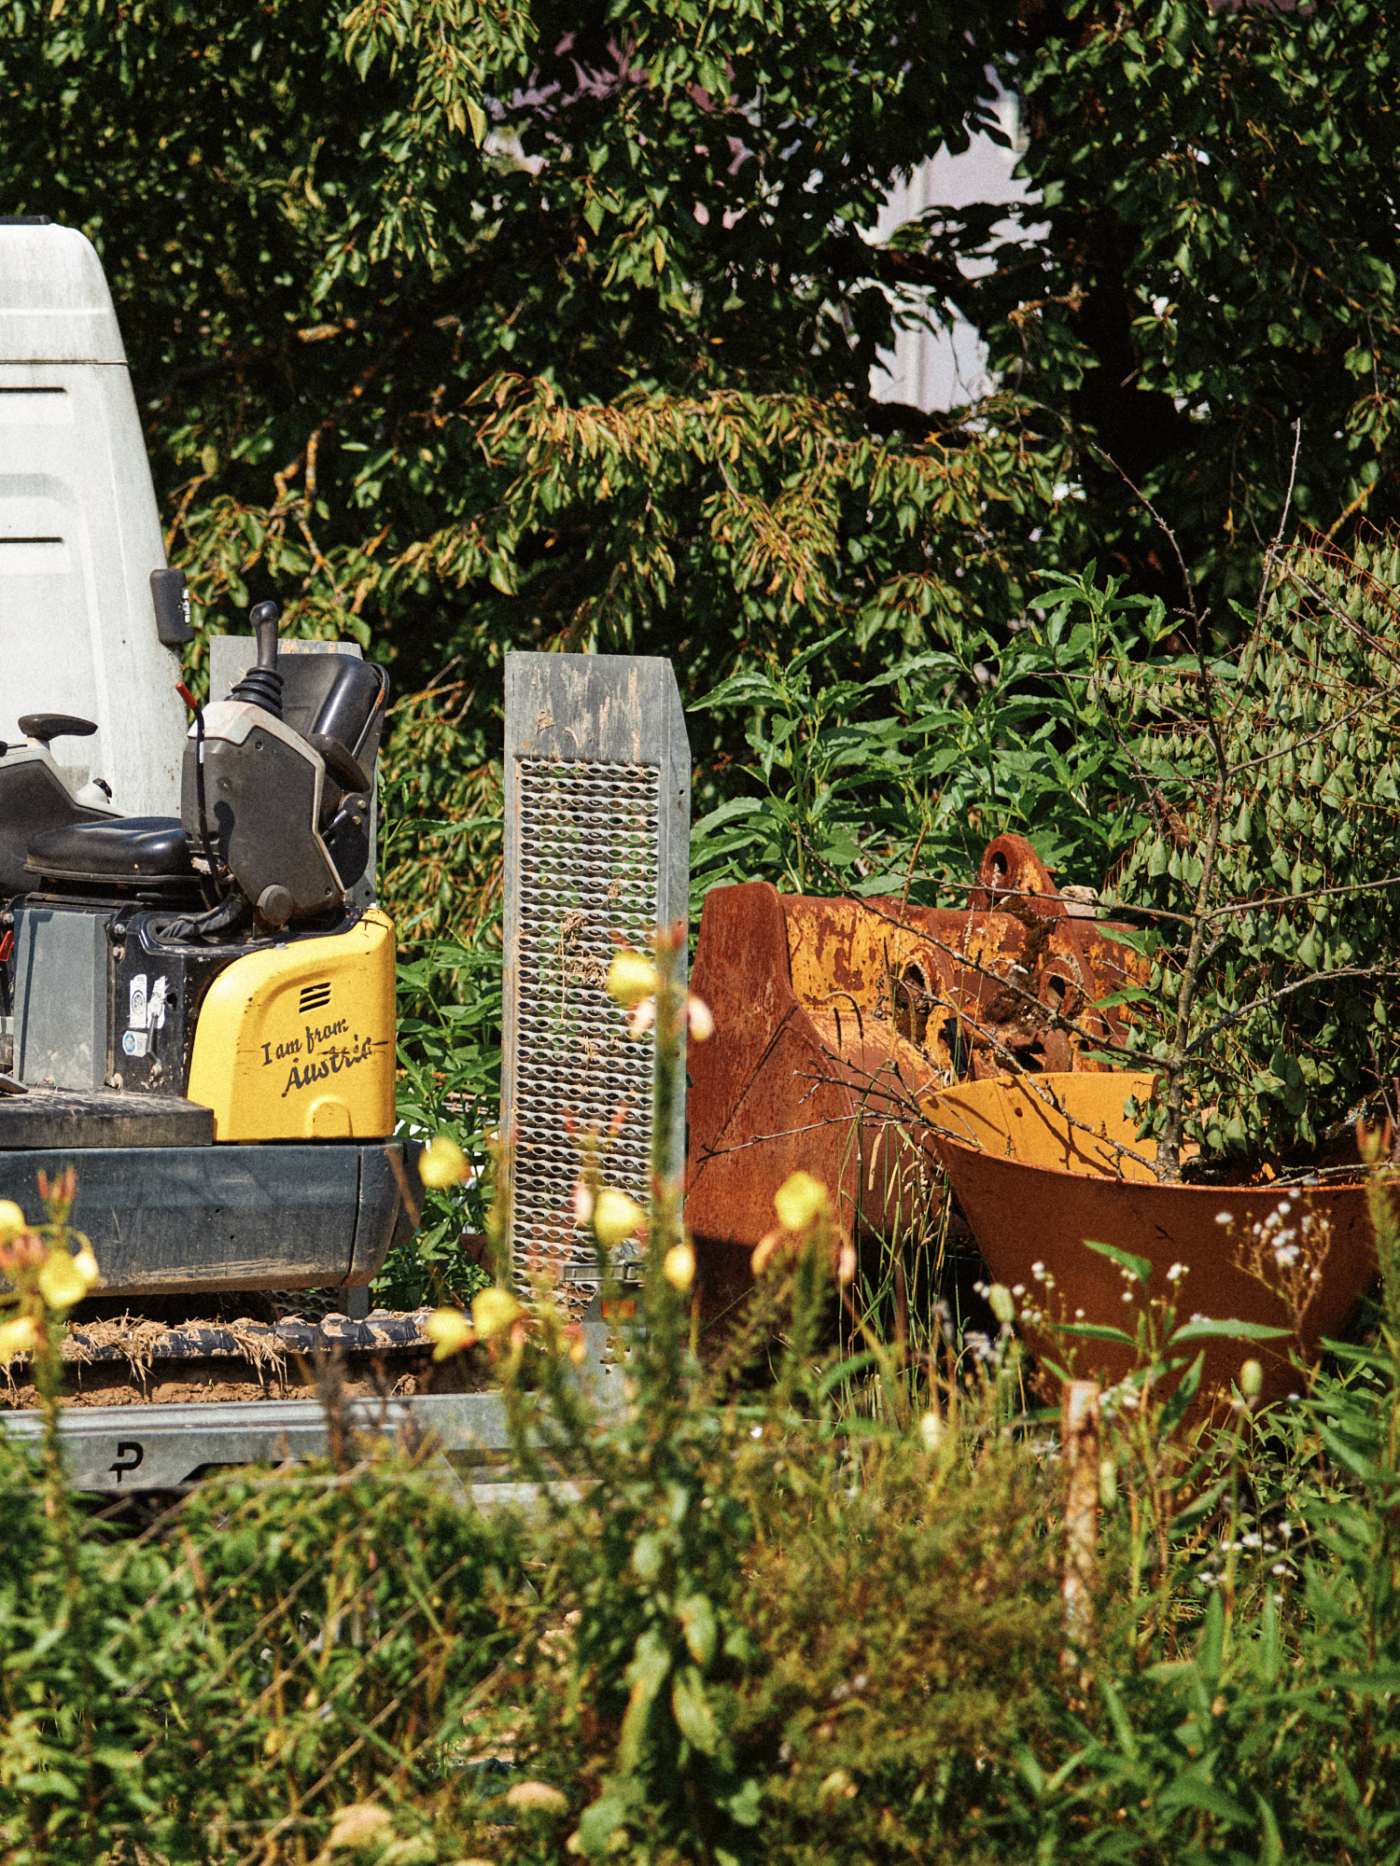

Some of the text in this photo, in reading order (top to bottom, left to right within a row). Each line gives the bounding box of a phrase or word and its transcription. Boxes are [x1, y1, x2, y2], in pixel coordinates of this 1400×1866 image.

[260, 1018, 349, 1067] I am from
